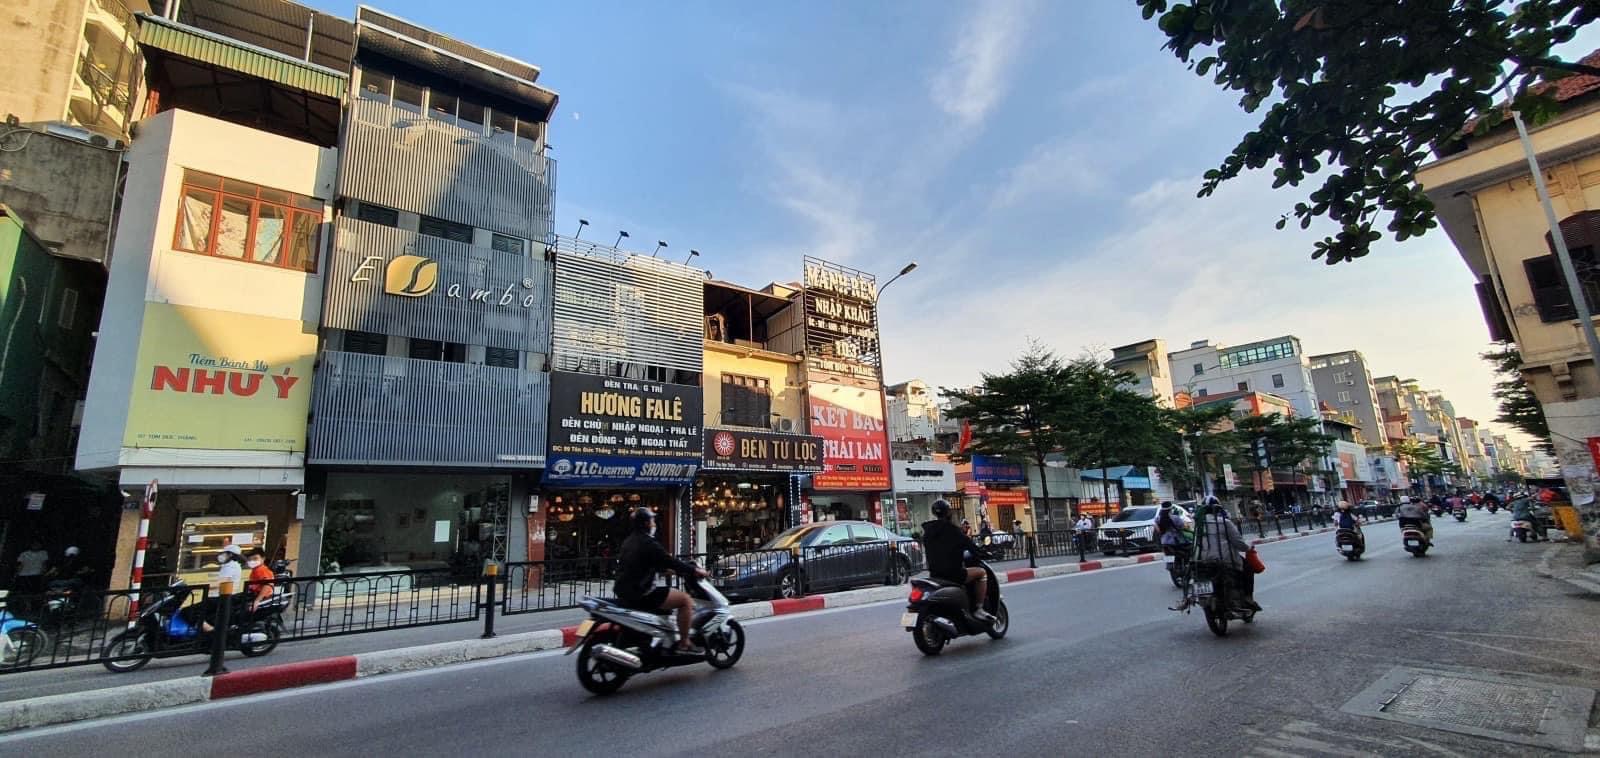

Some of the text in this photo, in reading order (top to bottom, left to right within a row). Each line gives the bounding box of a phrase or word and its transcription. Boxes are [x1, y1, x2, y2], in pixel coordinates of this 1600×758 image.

[815, 296, 842, 318] NHẬP
[835, 341, 857, 359] 103
[151, 365, 299, 399] NHƯ Ý
[604, 379, 663, 393] ĐÈN TRAG TRÍ
[580, 391, 683, 421] HƯƠNG FALÊ
[561, 416, 581, 428] ĐÈN
[611, 421, 636, 434] NHẬP
[638, 424, 664, 437] NGOẠI
[671, 426, 686, 436] PHA
[688, 425, 697, 436] LÊ
[852, 412, 884, 436] BẠC
[570, 433, 589, 444] ĐÈN
[591, 431, 617, 445] ĐỒNG
[641, 437, 666, 448] NGOẠI
[669, 437, 689, 449] THẤT
[741, 437, 768, 459] ĐÈN
[794, 440, 817, 463] LỘC
[823, 436, 882, 460] THÁI LAN
[574, 461, 599, 475] TLC
[640, 463, 697, 477] SHOWROM
